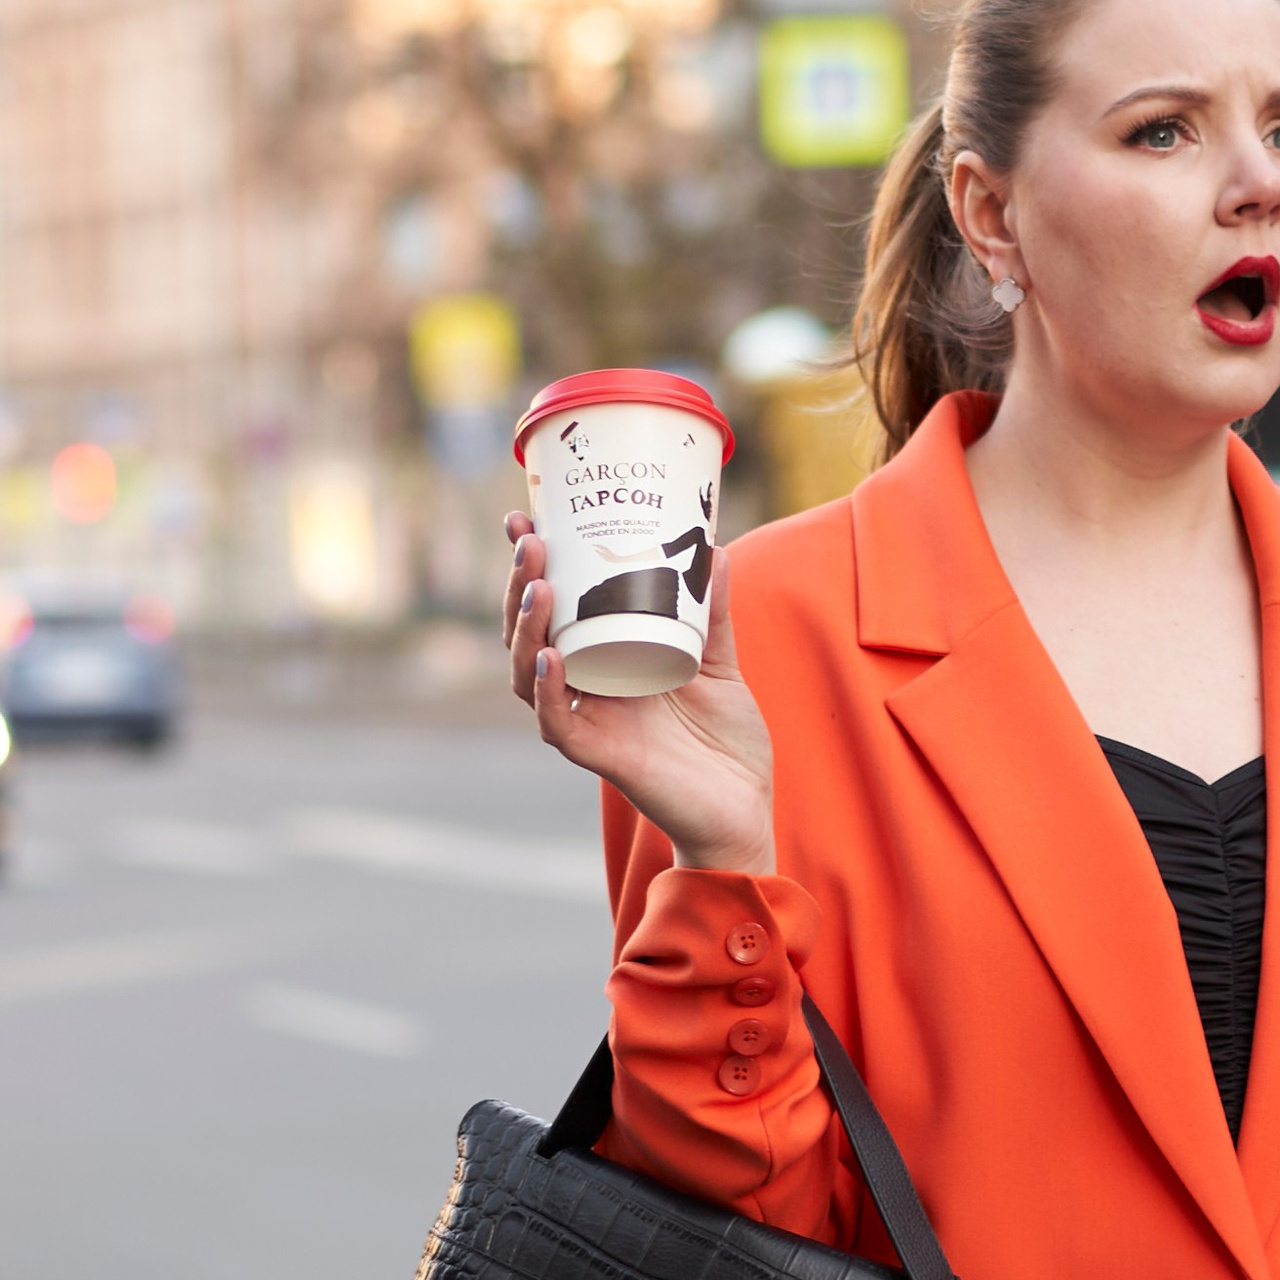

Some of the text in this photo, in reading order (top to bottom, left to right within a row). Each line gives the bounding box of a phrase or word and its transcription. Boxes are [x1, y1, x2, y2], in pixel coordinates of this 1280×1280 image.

[565, 462, 666, 486] GARÇON
[570, 488, 664, 514] ГАРСОН
[576, 521, 607, 531] MAISON
